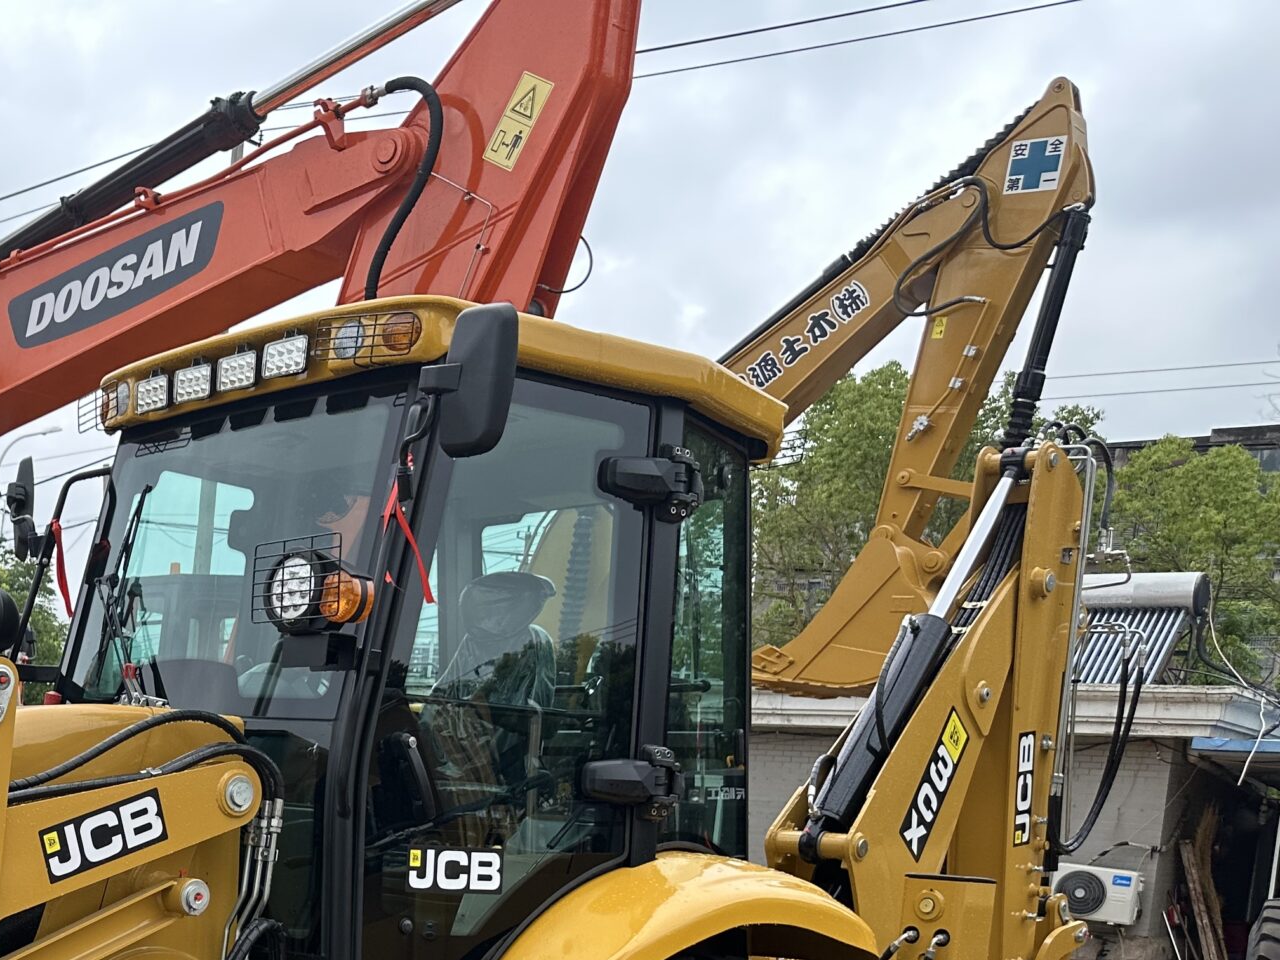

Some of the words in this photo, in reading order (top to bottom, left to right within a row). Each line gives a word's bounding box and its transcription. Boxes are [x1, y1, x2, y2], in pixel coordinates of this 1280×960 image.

[25, 220, 203, 338] DOOSAN
[736, 281, 869, 388] 源土木(株)
[48, 796, 164, 877] JCB
[903, 744, 954, 857] 3CX
[1015, 733, 1035, 843] JCB
[408, 849, 501, 890] JCB
